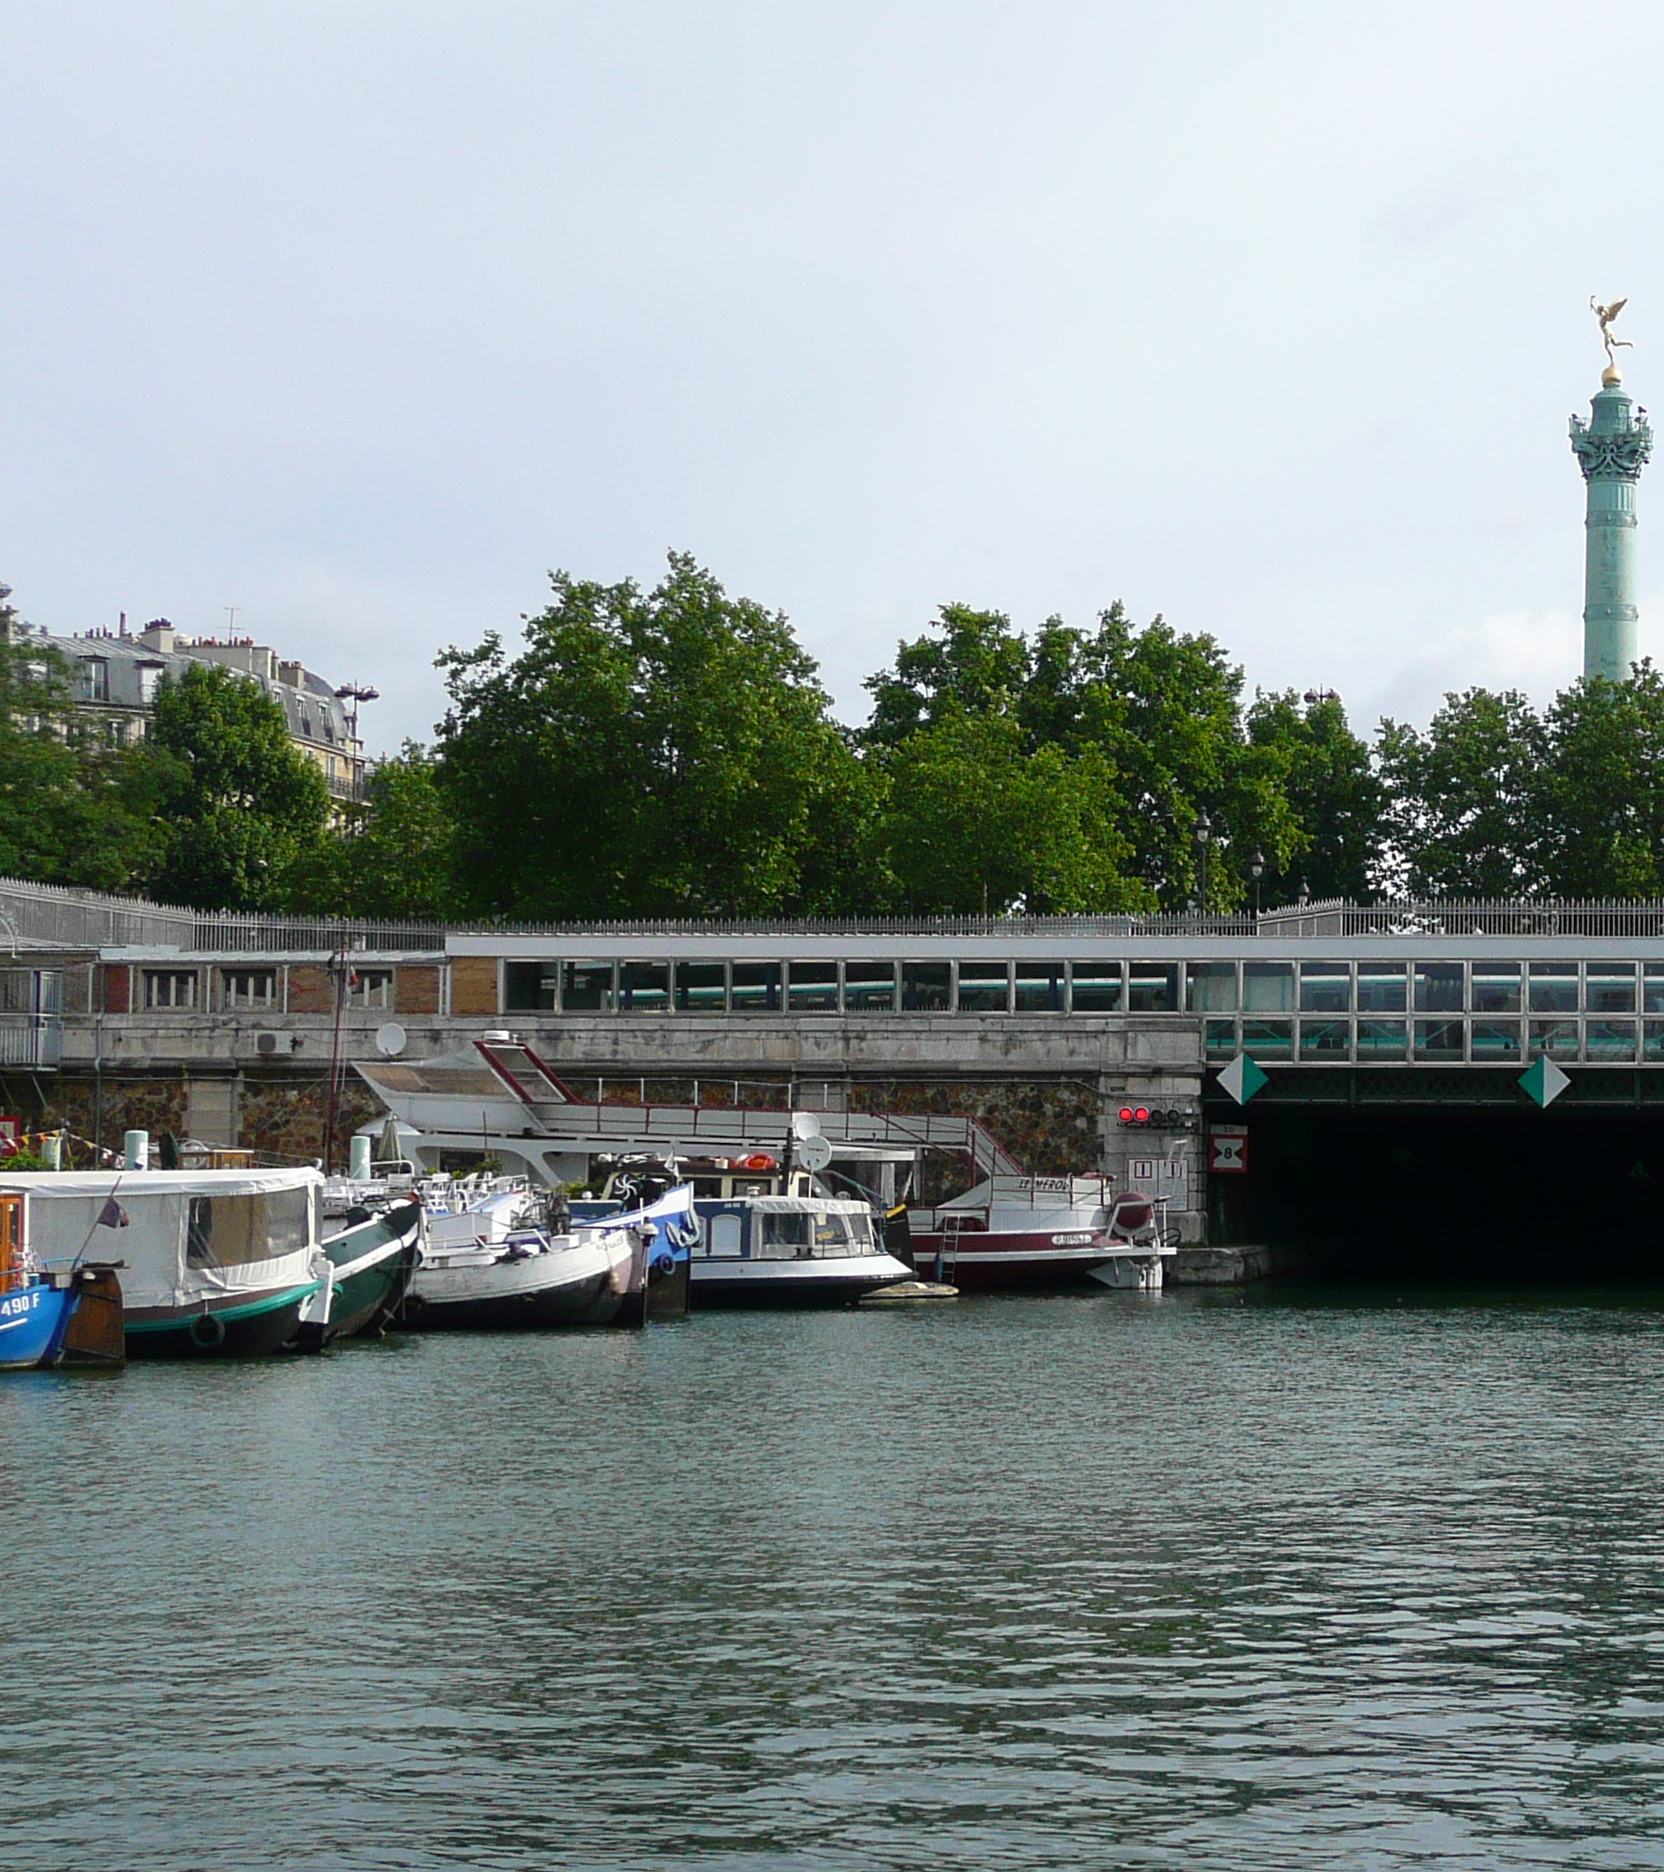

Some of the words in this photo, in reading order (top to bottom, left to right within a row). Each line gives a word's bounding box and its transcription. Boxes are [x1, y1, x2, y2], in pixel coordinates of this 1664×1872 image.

[1223, 1147, 1233, 1160] 8
[1, 1295, 30, 1317] 490
[32, 1292, 40, 1308] F
